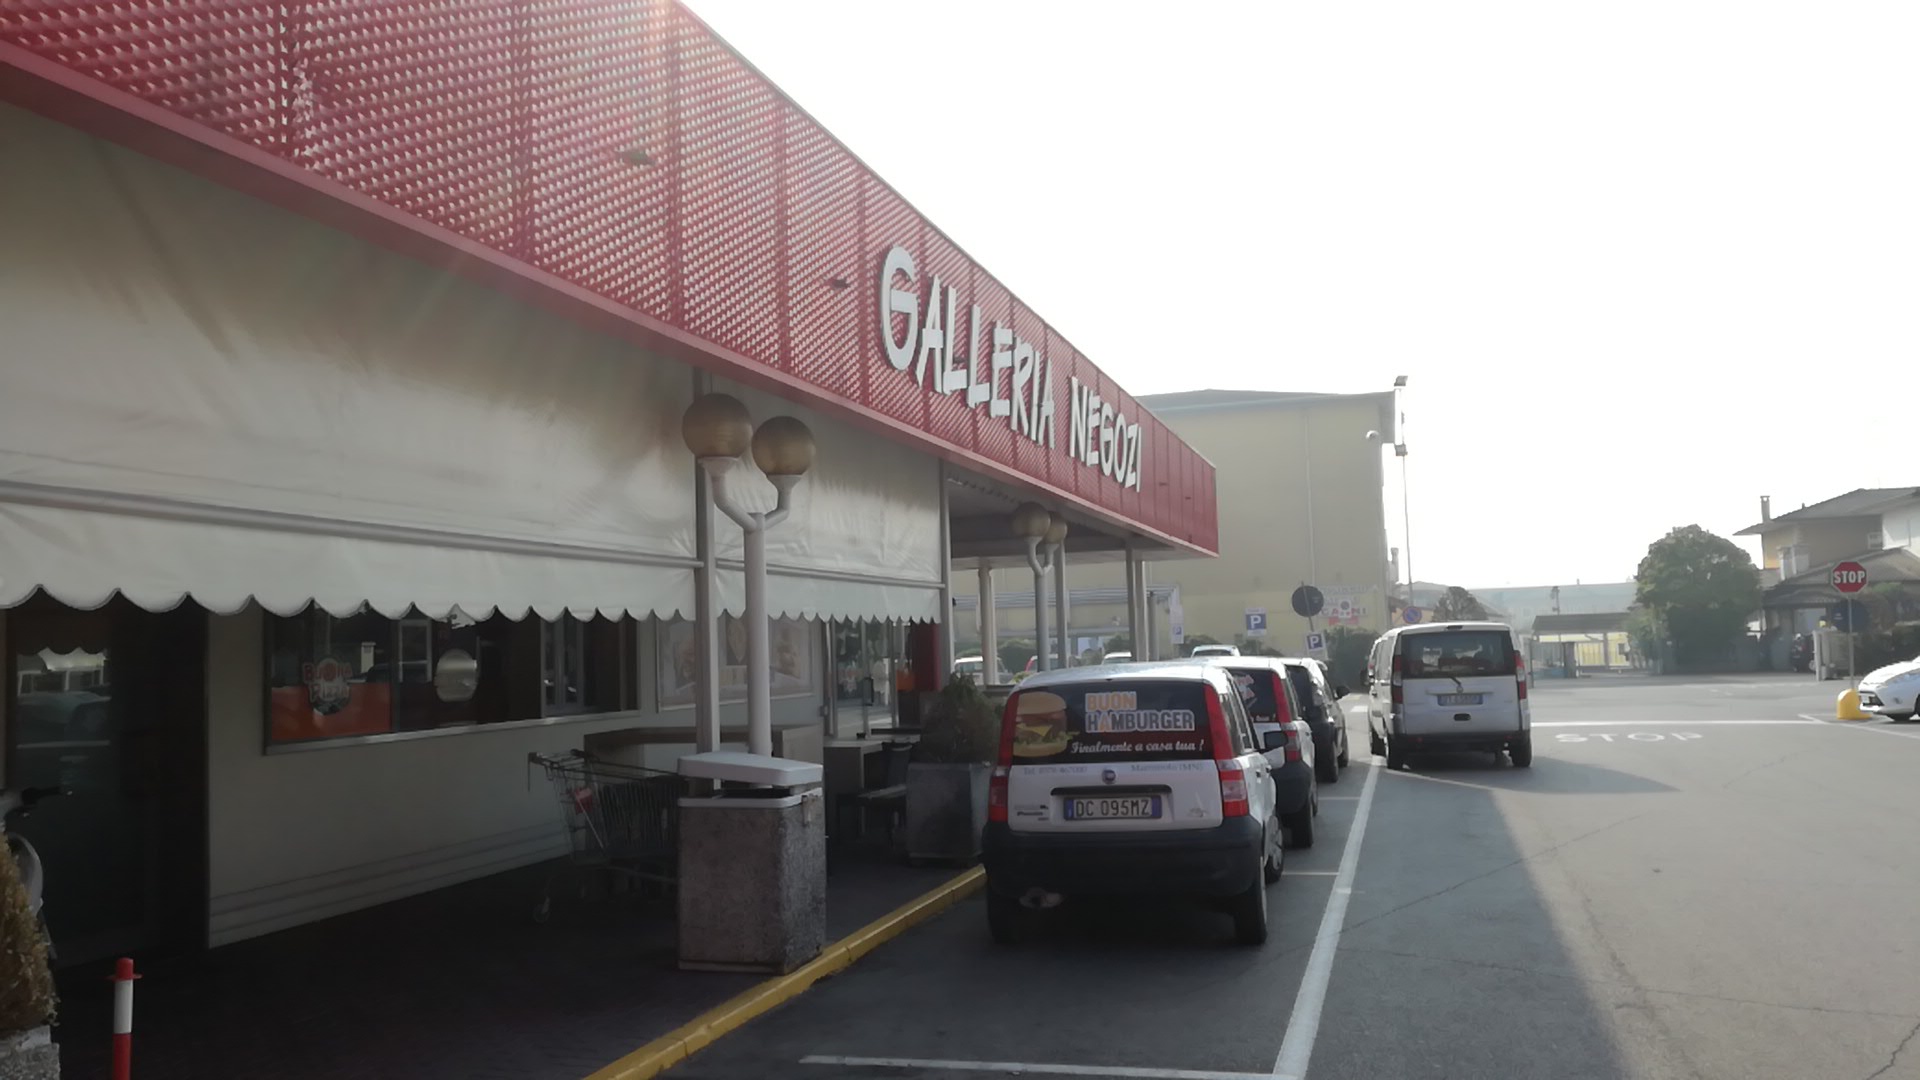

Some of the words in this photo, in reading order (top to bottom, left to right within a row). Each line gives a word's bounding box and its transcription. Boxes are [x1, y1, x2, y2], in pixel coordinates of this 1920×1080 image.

[881, 245, 1056, 449] GALLERIA
[1069, 376, 1142, 492] NEGOZI
[1832, 570, 1866, 584] STOP
[1250, 615, 1262, 629] P
[1309, 636, 1320, 649] P
[1085, 691, 1137, 711] BUON
[1086, 710, 1195, 733] HAMBURGER
[1554, 732, 1704, 743] STOP
[1071, 741, 1133, 753] Finalmente
[1135, 744, 1143, 752] a
[1145, 743, 1173, 752] casa
[1175, 741, 1196, 752] tua
[1075, 800, 1095, 818] DC
[1100, 799, 1152, 818] 095MZ
